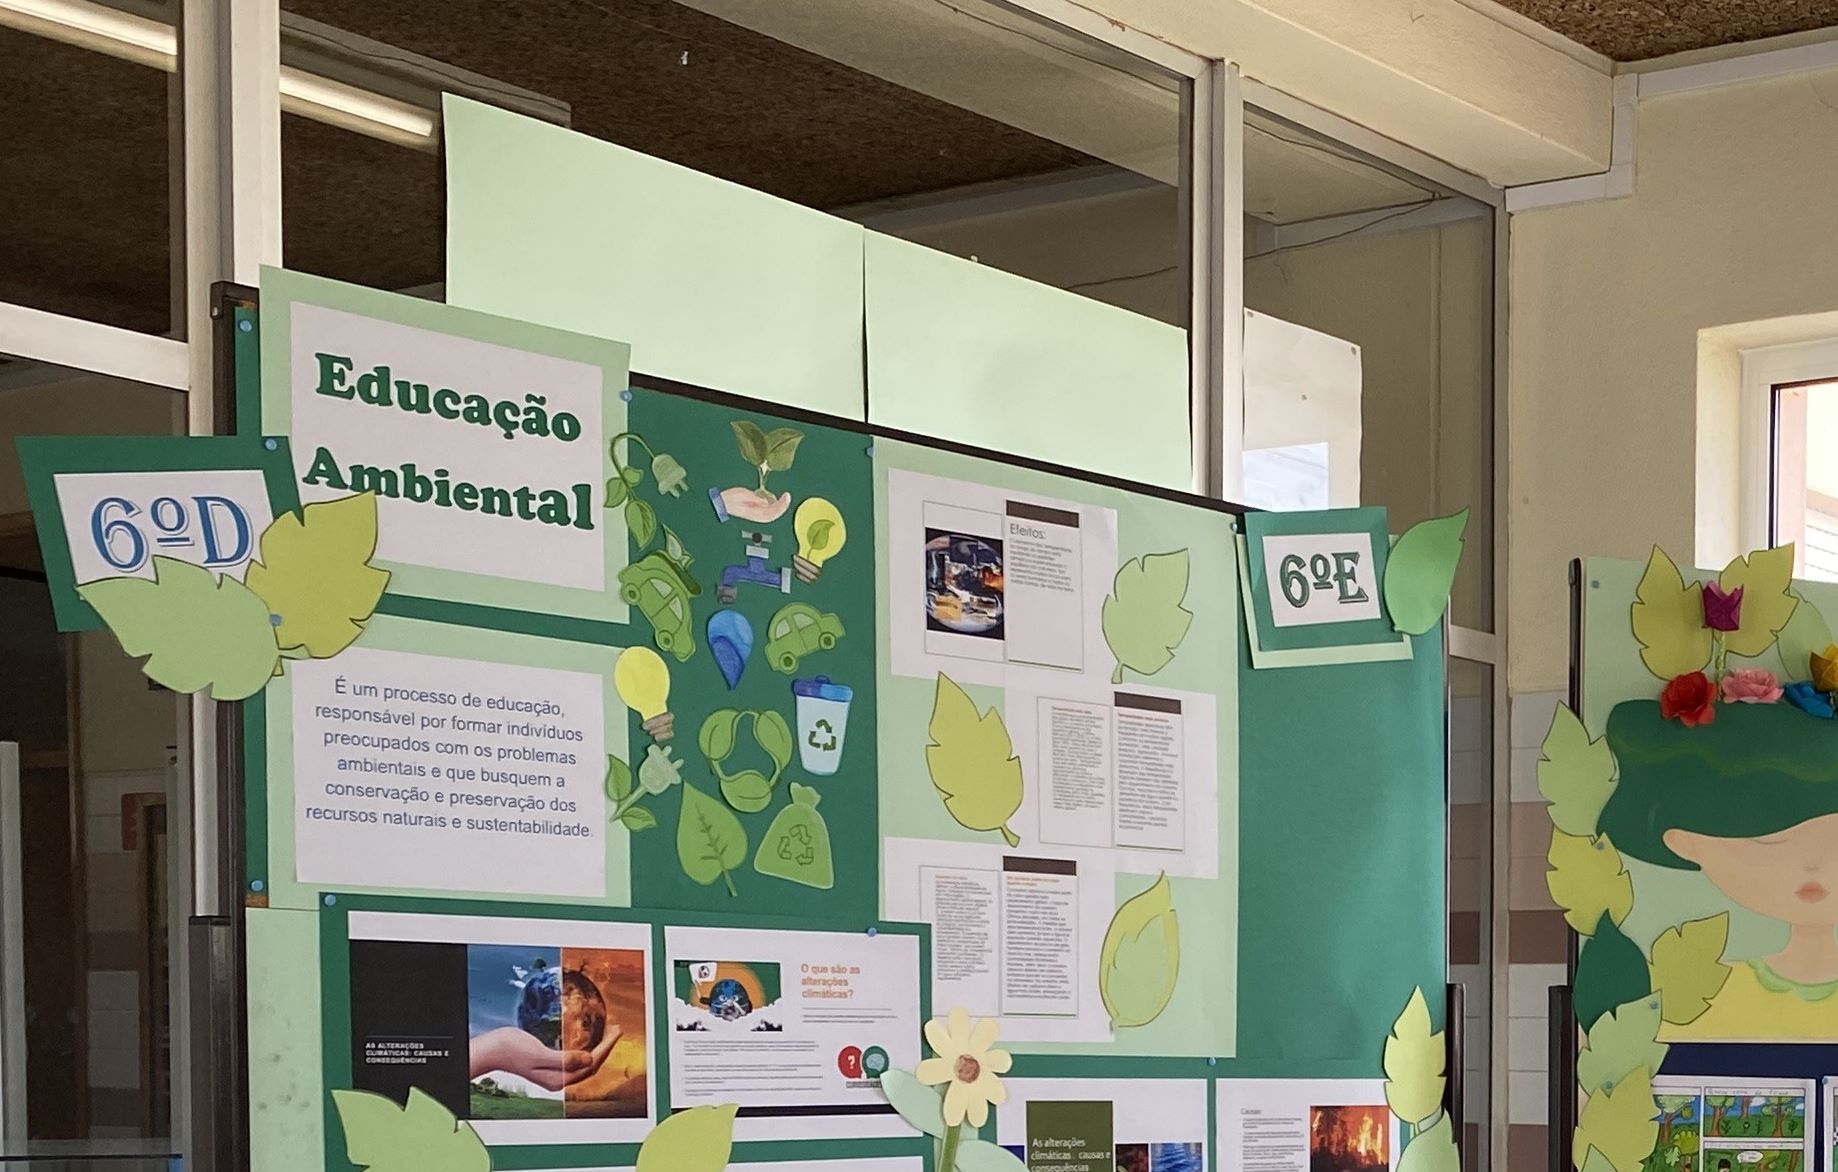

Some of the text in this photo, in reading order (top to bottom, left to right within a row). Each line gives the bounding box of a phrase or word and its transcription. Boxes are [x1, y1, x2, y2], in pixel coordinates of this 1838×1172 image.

[315, 352, 582, 442] Educação
[302, 446, 595, 531] Ambiental
[91, 496, 253, 573] 6ºD
[1279, 552, 1369, 608] 6ºE
[334, 675, 566, 718] É um processo de educação,
[315, 704, 584, 742] responsável por formar indivíduos
[323, 730, 577, 766] preocupados com os problemas
[337, 756, 566, 792] ambientais e que busquem a
[325, 782, 577, 813] conservação e preservação dos
[306, 805, 378, 824] recursos
[383, 811, 447, 828] naturais
[451, 816, 462, 829] e
[800, 963, 809, 974] O
[811, 966, 829, 975] que
[830, 964, 848, 974] são
[801, 977, 849, 988] alterações
[1032, 1136, 1086, 1150] As alterações
[1078, 1151, 1104, 1160] causas
